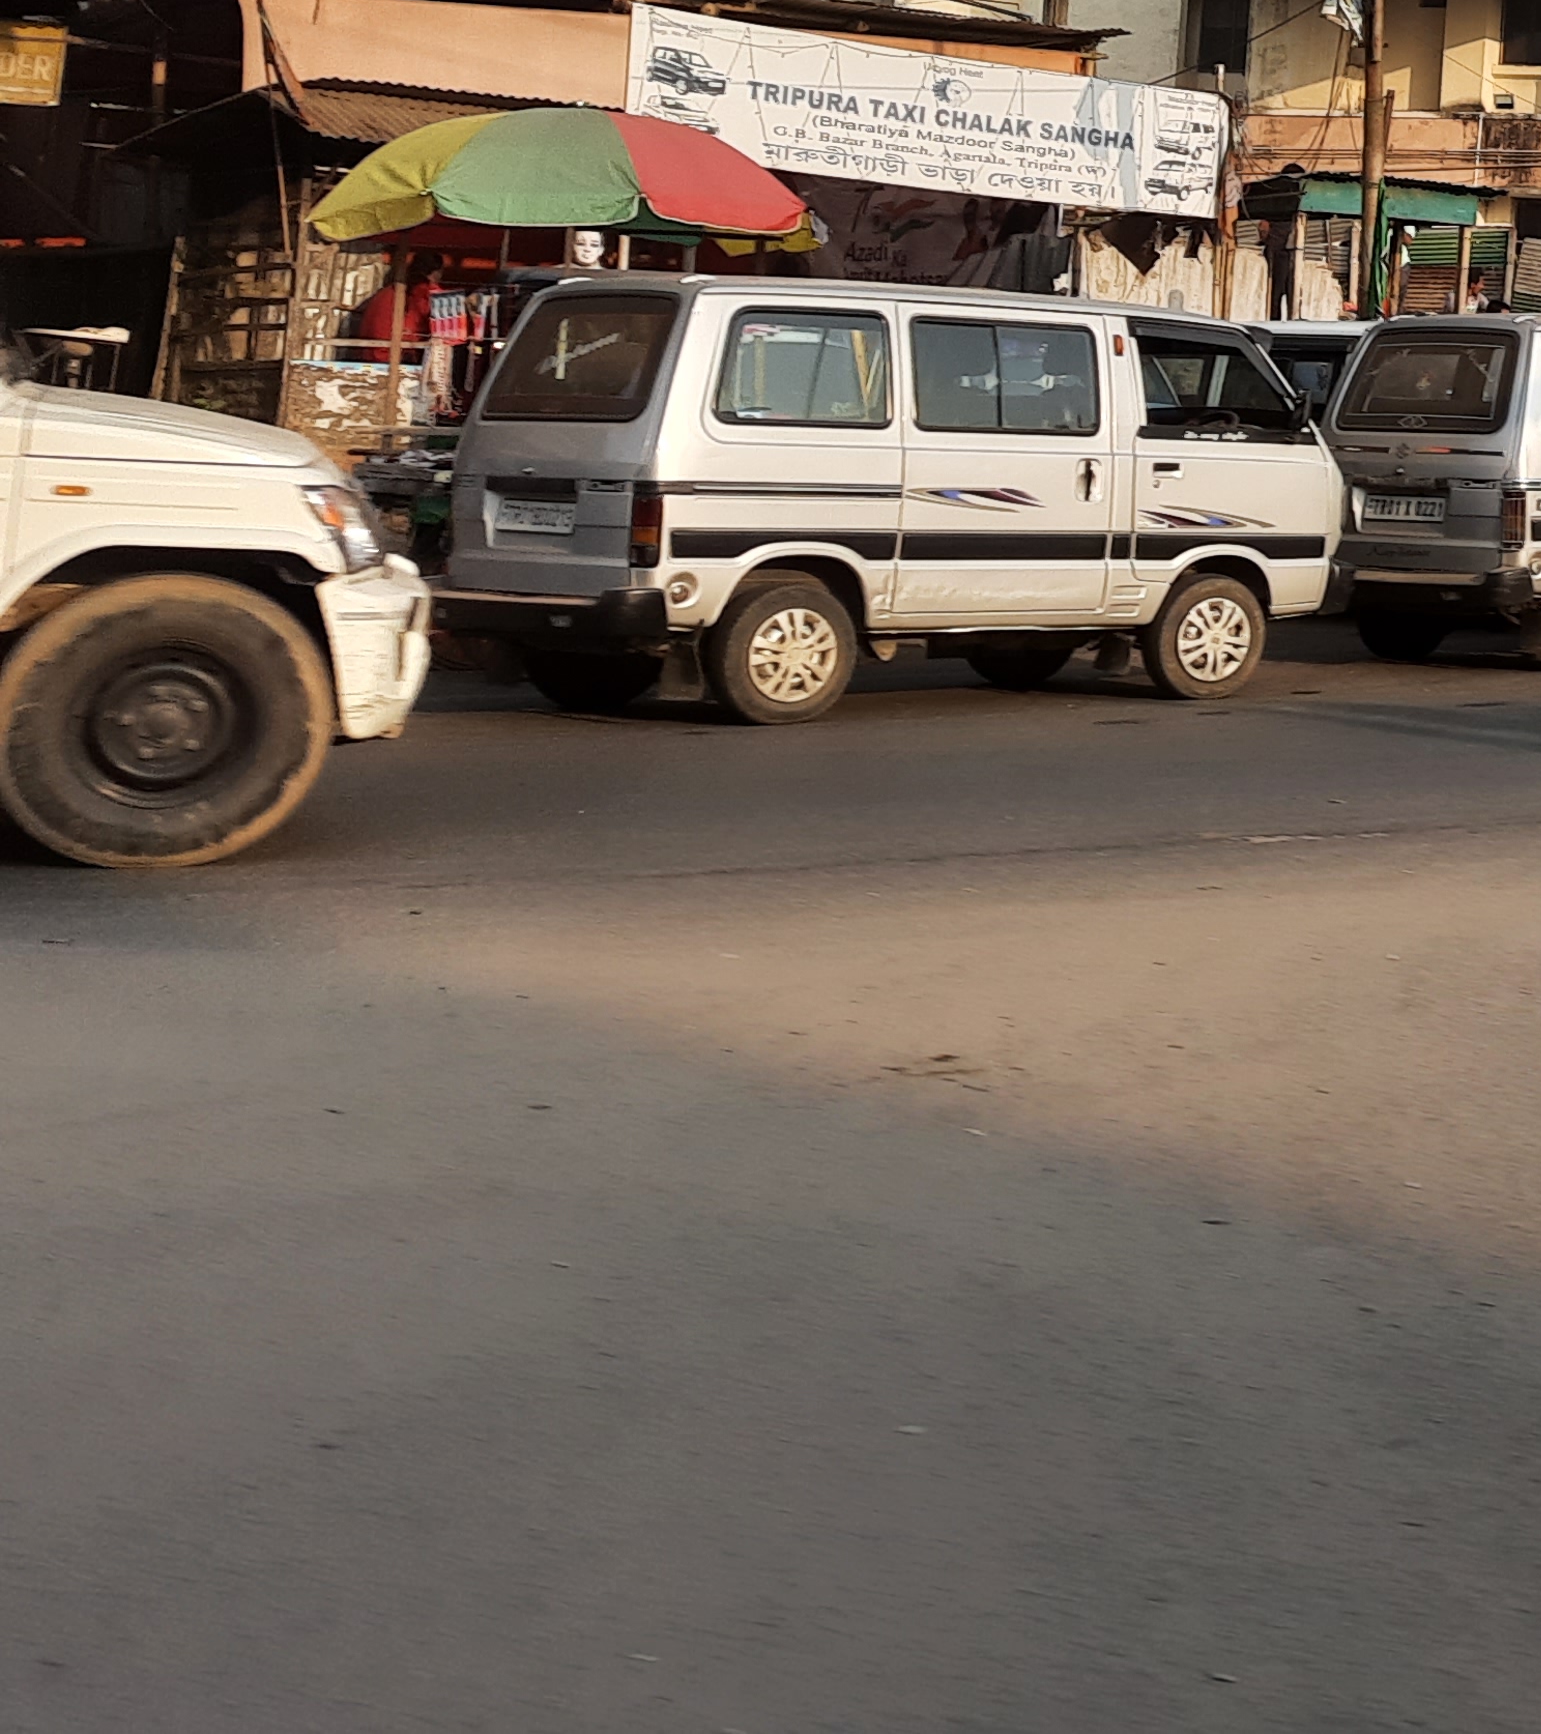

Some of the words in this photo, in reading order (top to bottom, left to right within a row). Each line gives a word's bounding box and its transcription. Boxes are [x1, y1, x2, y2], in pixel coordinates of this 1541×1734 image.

[747, 79, 859, 115] TRIPURA
[869, 98, 926, 124] TAXI
[935, 109, 1033, 138] CHALAK
[1039, 122, 1135, 150] SANGHA
[812, 115, 909, 139] (Bharatiya
[917, 128, 996, 149] Mazdoor
[1000, 140, 1076, 161] Sangha)
[818, 132, 868, 147] Bazar
[1014, 156, 1073, 173] Tripura
[843, 240, 888, 262] Azadi
